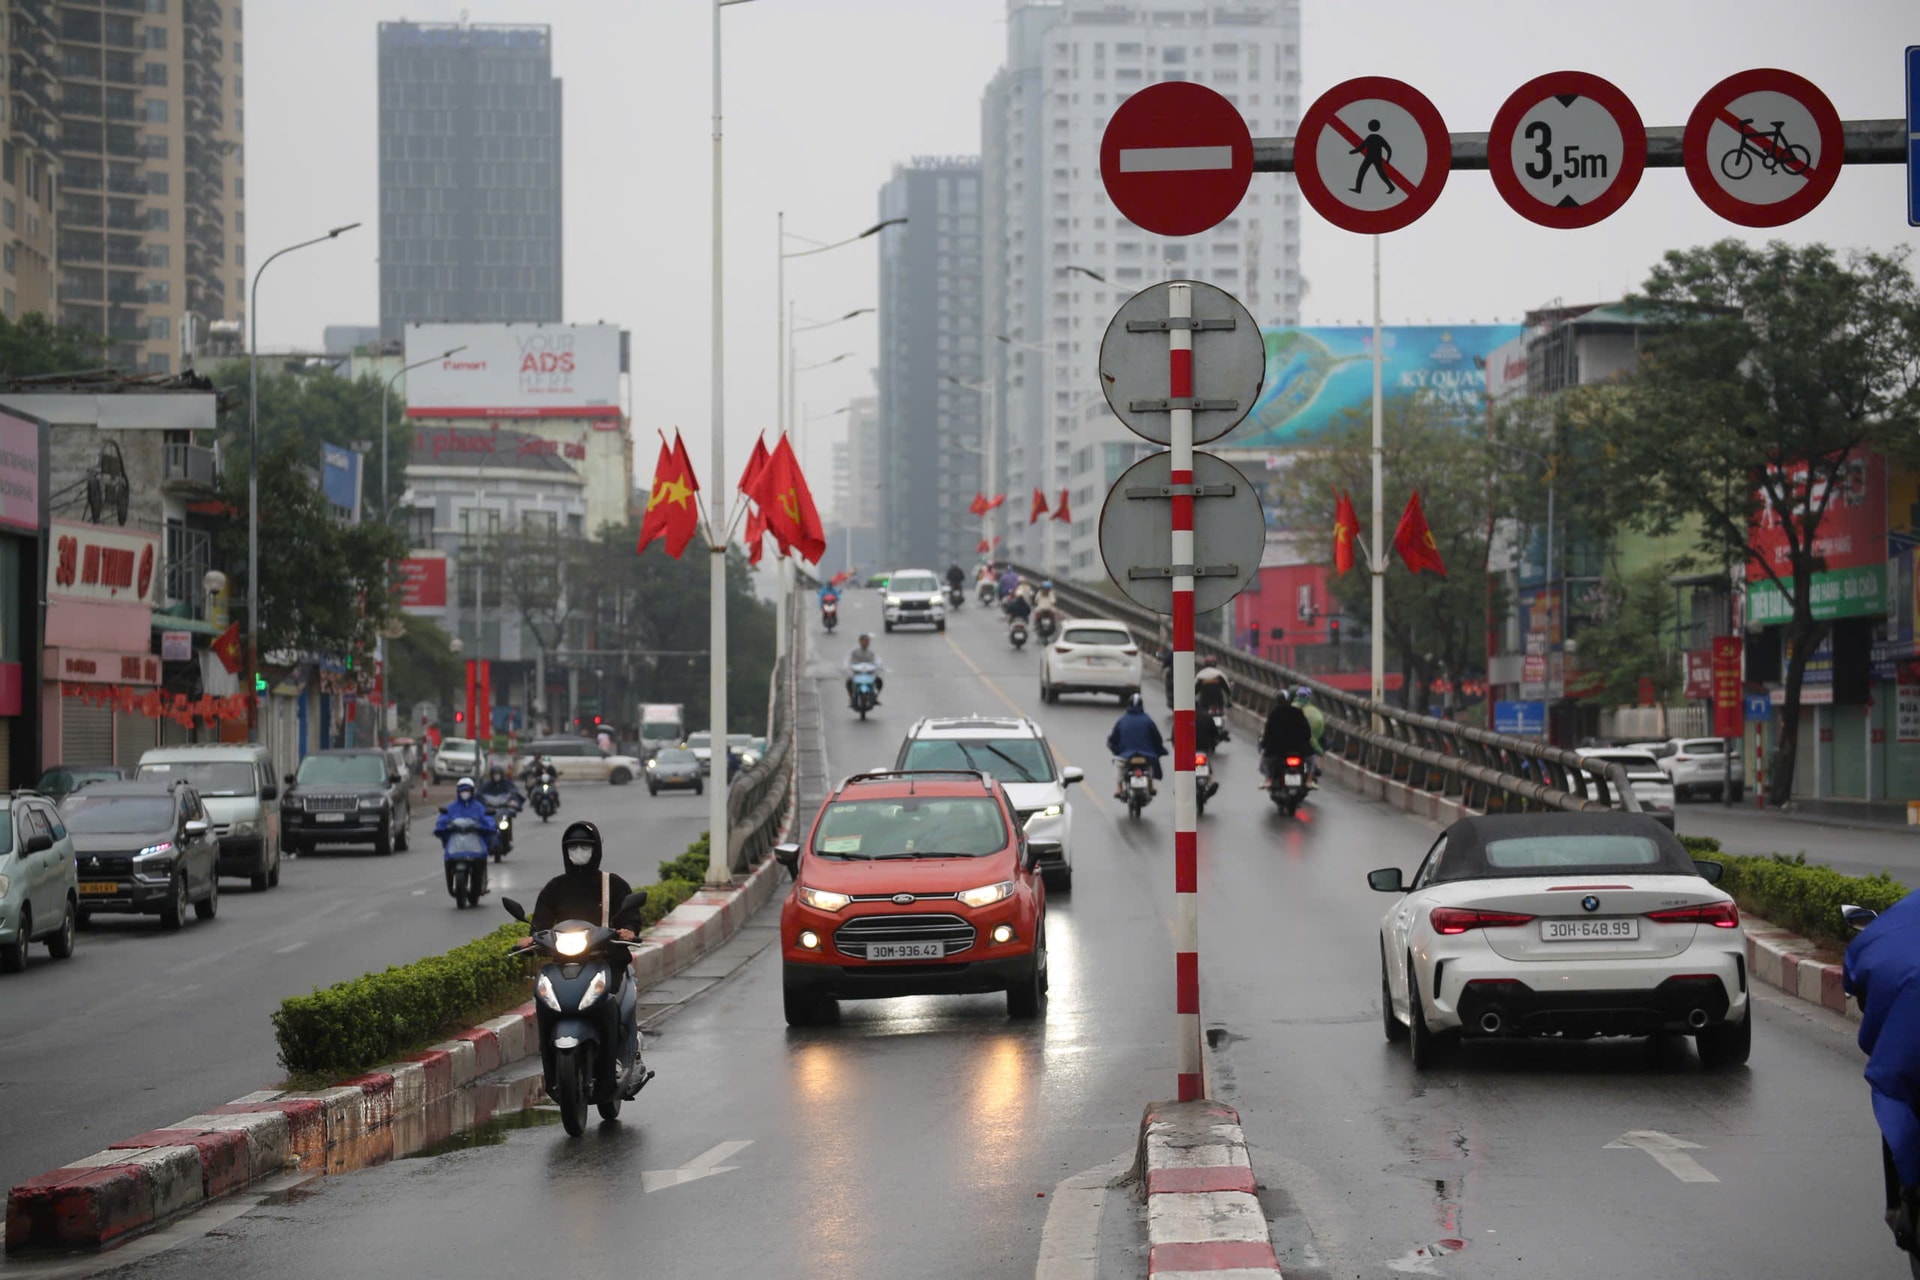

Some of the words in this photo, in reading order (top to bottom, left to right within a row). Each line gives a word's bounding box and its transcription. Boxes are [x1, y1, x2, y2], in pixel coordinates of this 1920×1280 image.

[1525, 121, 1607, 188] 3,5m
[516, 334, 576, 353] YOUR
[520, 352, 576, 373] ADS
[519, 373, 575, 387] HERE
[1431, 370, 1487, 389] QUAN
[1549, 922, 1631, 937] 30H-648.99
[873, 945, 938, 958] 30M-936.42
